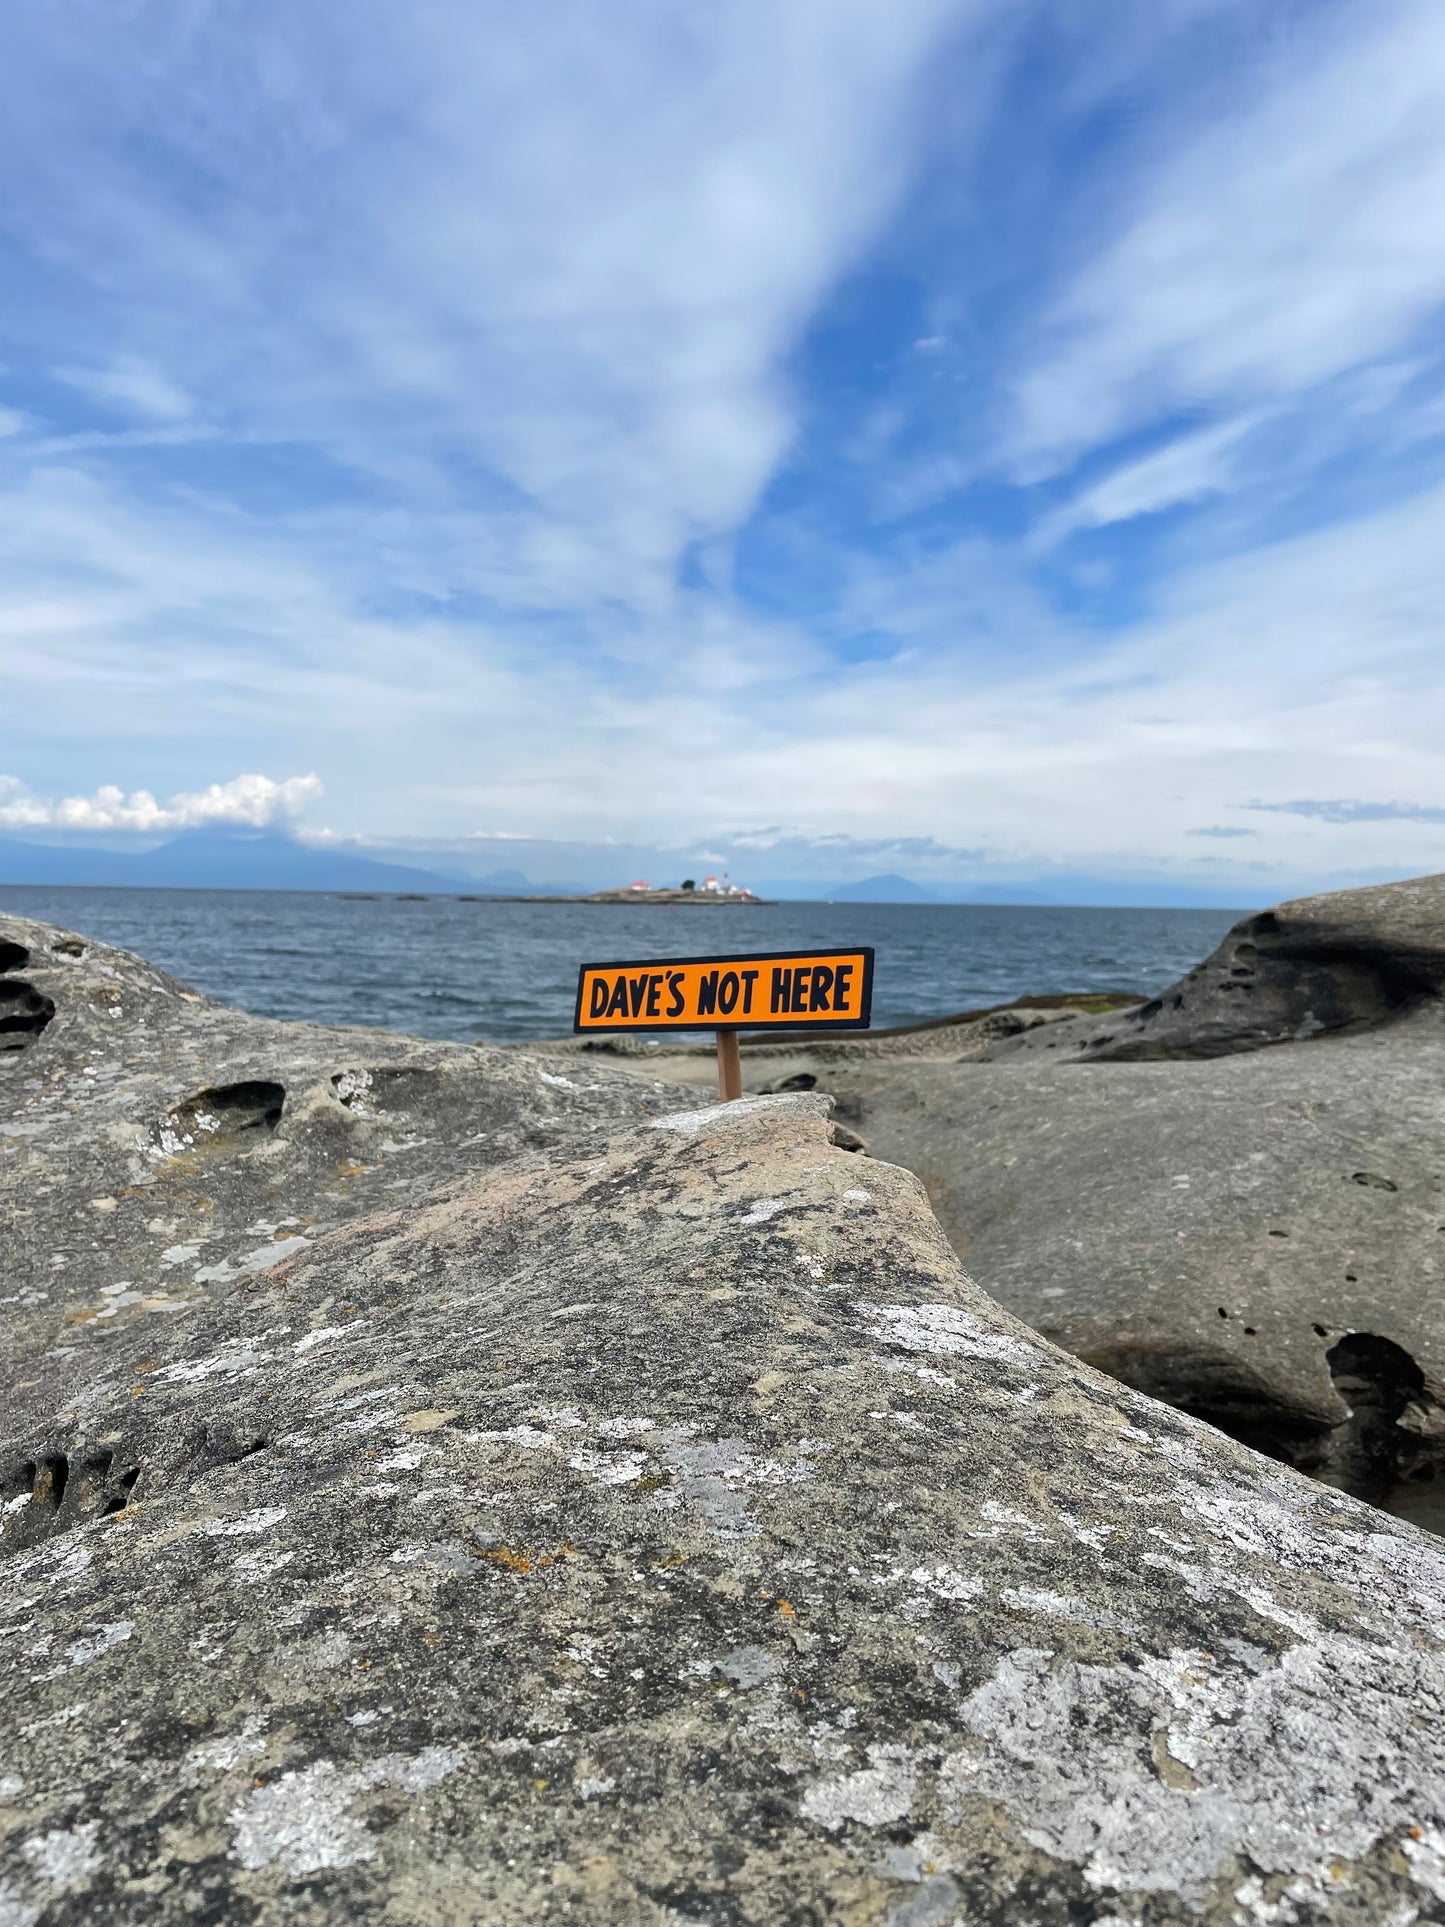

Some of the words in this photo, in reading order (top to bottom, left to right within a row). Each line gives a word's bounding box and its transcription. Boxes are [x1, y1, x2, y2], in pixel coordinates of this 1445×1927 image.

[590, 970, 685, 1019] DAVE'S
[697, 970, 759, 1016] NOT
[770, 965, 854, 1014] HERE
